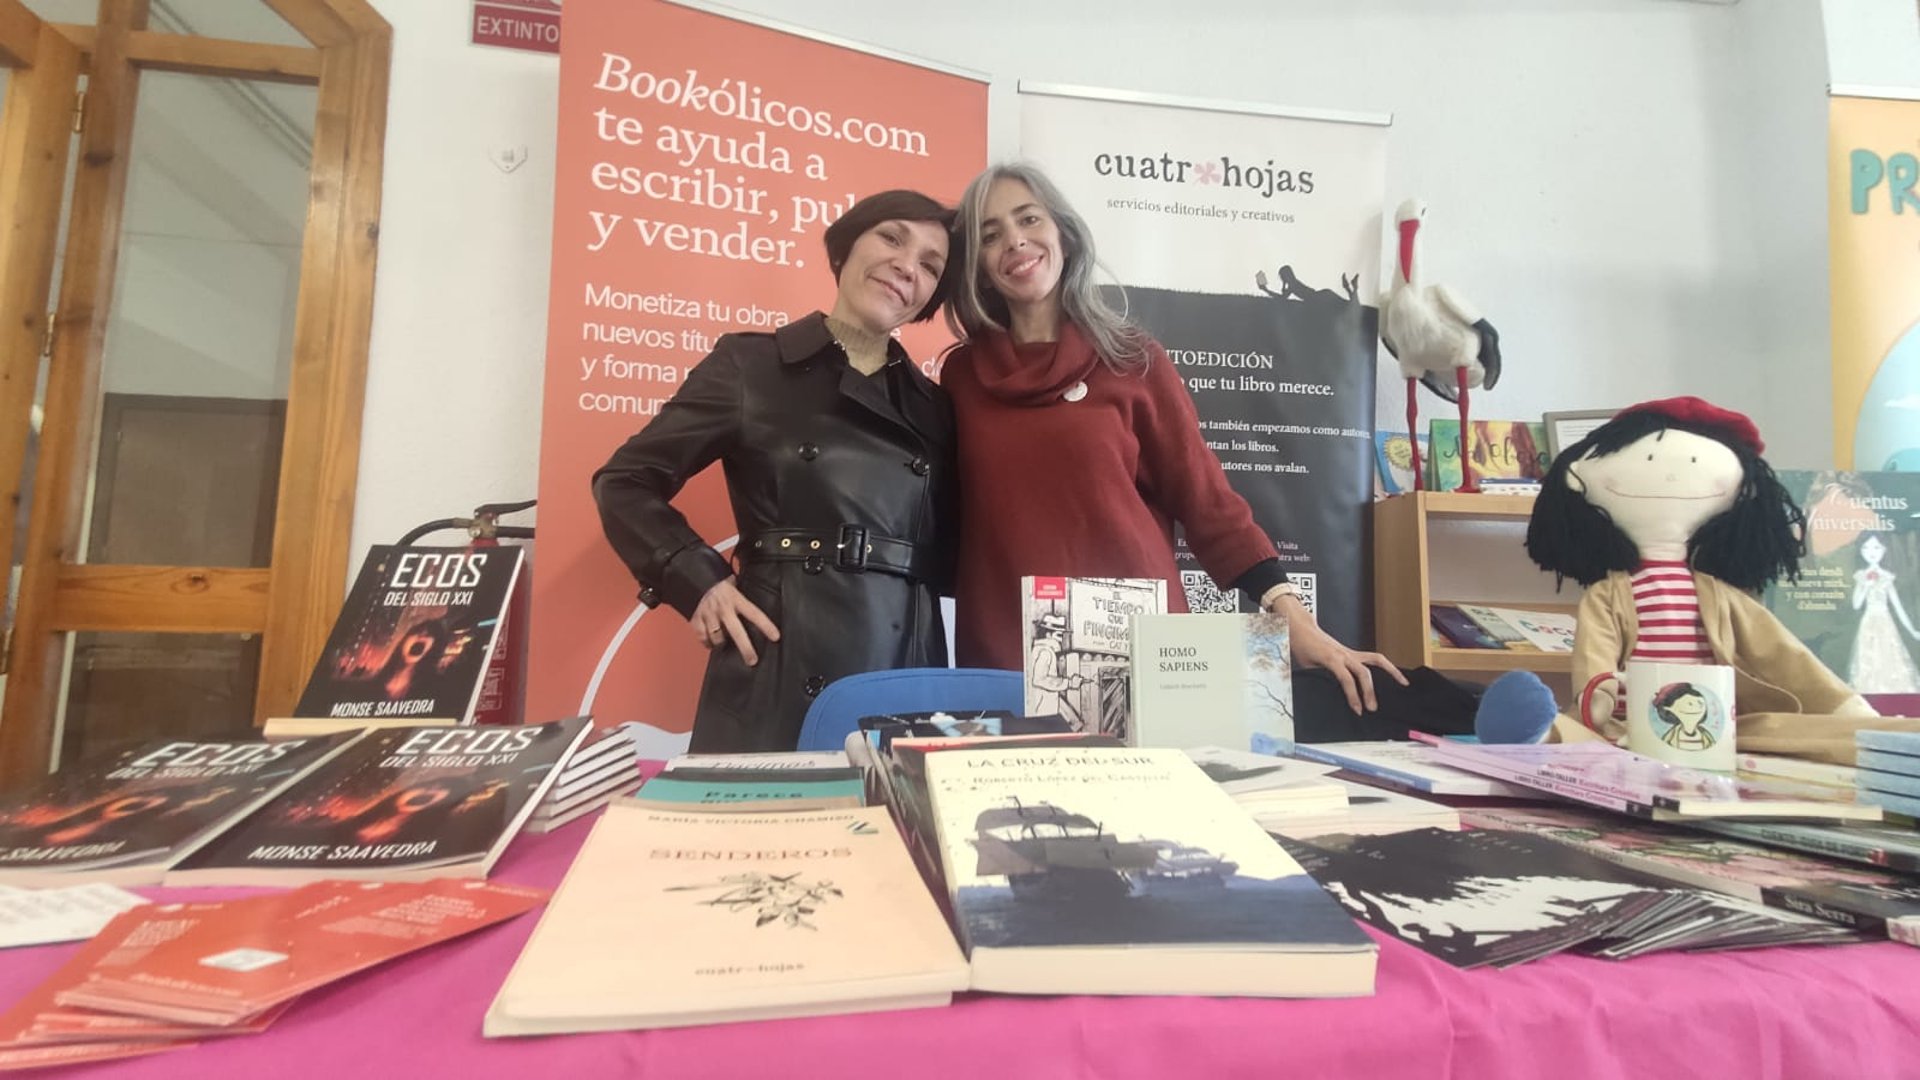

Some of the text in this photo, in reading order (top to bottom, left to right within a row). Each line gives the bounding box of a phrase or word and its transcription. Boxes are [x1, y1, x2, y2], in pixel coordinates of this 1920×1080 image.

[594, 52, 929, 156] Bookólicos.com
[594, 106, 829, 180] te ayuda a
[591, 161, 779, 224] escribir,
[1107, 197, 1295, 224] servicios editoriales y creativos
[587, 209, 805, 268] y vender.
[585, 283, 700, 319] Monetiza
[706, 300, 730, 322] tu
[583, 322, 725, 353] nuevos títu
[580, 357, 597, 380] y
[603, 354, 677, 383] forma
[1189, 376, 1334, 396] que tu libro merece.
[579, 392, 674, 416] comun
[1209, 420, 1250, 431] también
[1252, 424, 1310, 435] empezamos
[1312, 427, 1340, 436] como
[1231, 442, 1246, 451] los
[1249, 441, 1279, 452] libros.
[1255, 463, 1272, 472] nos
[1275, 462, 1309, 474] avalan.
[390, 553, 488, 588] ECOS
[383, 591, 474, 606] DEL SIGLO XXI
[1092, 596, 1144, 616] TIEMPO
[1159, 646, 1197, 658] HOMO
[1159, 661, 1209, 672] SAPIENS
[330, 699, 435, 718] MONSE SAAVEDRA
[395, 726, 544, 755] ECOS
[131, 740, 307, 767] ECOS
[379, 752, 519, 768] DEL SIGLO XXI
[967, 759, 995, 768] LA
[1001, 758, 1056, 767] CRUZ
[1111, 757, 1155, 765] SUR
[105, 763, 266, 780] DEL SIGLO XXI
[1, 841, 127, 861] SAAVEDRA
[248, 840, 438, 861] MONSE SAAVEDRA
[649, 847, 852, 860] SENDEROS
